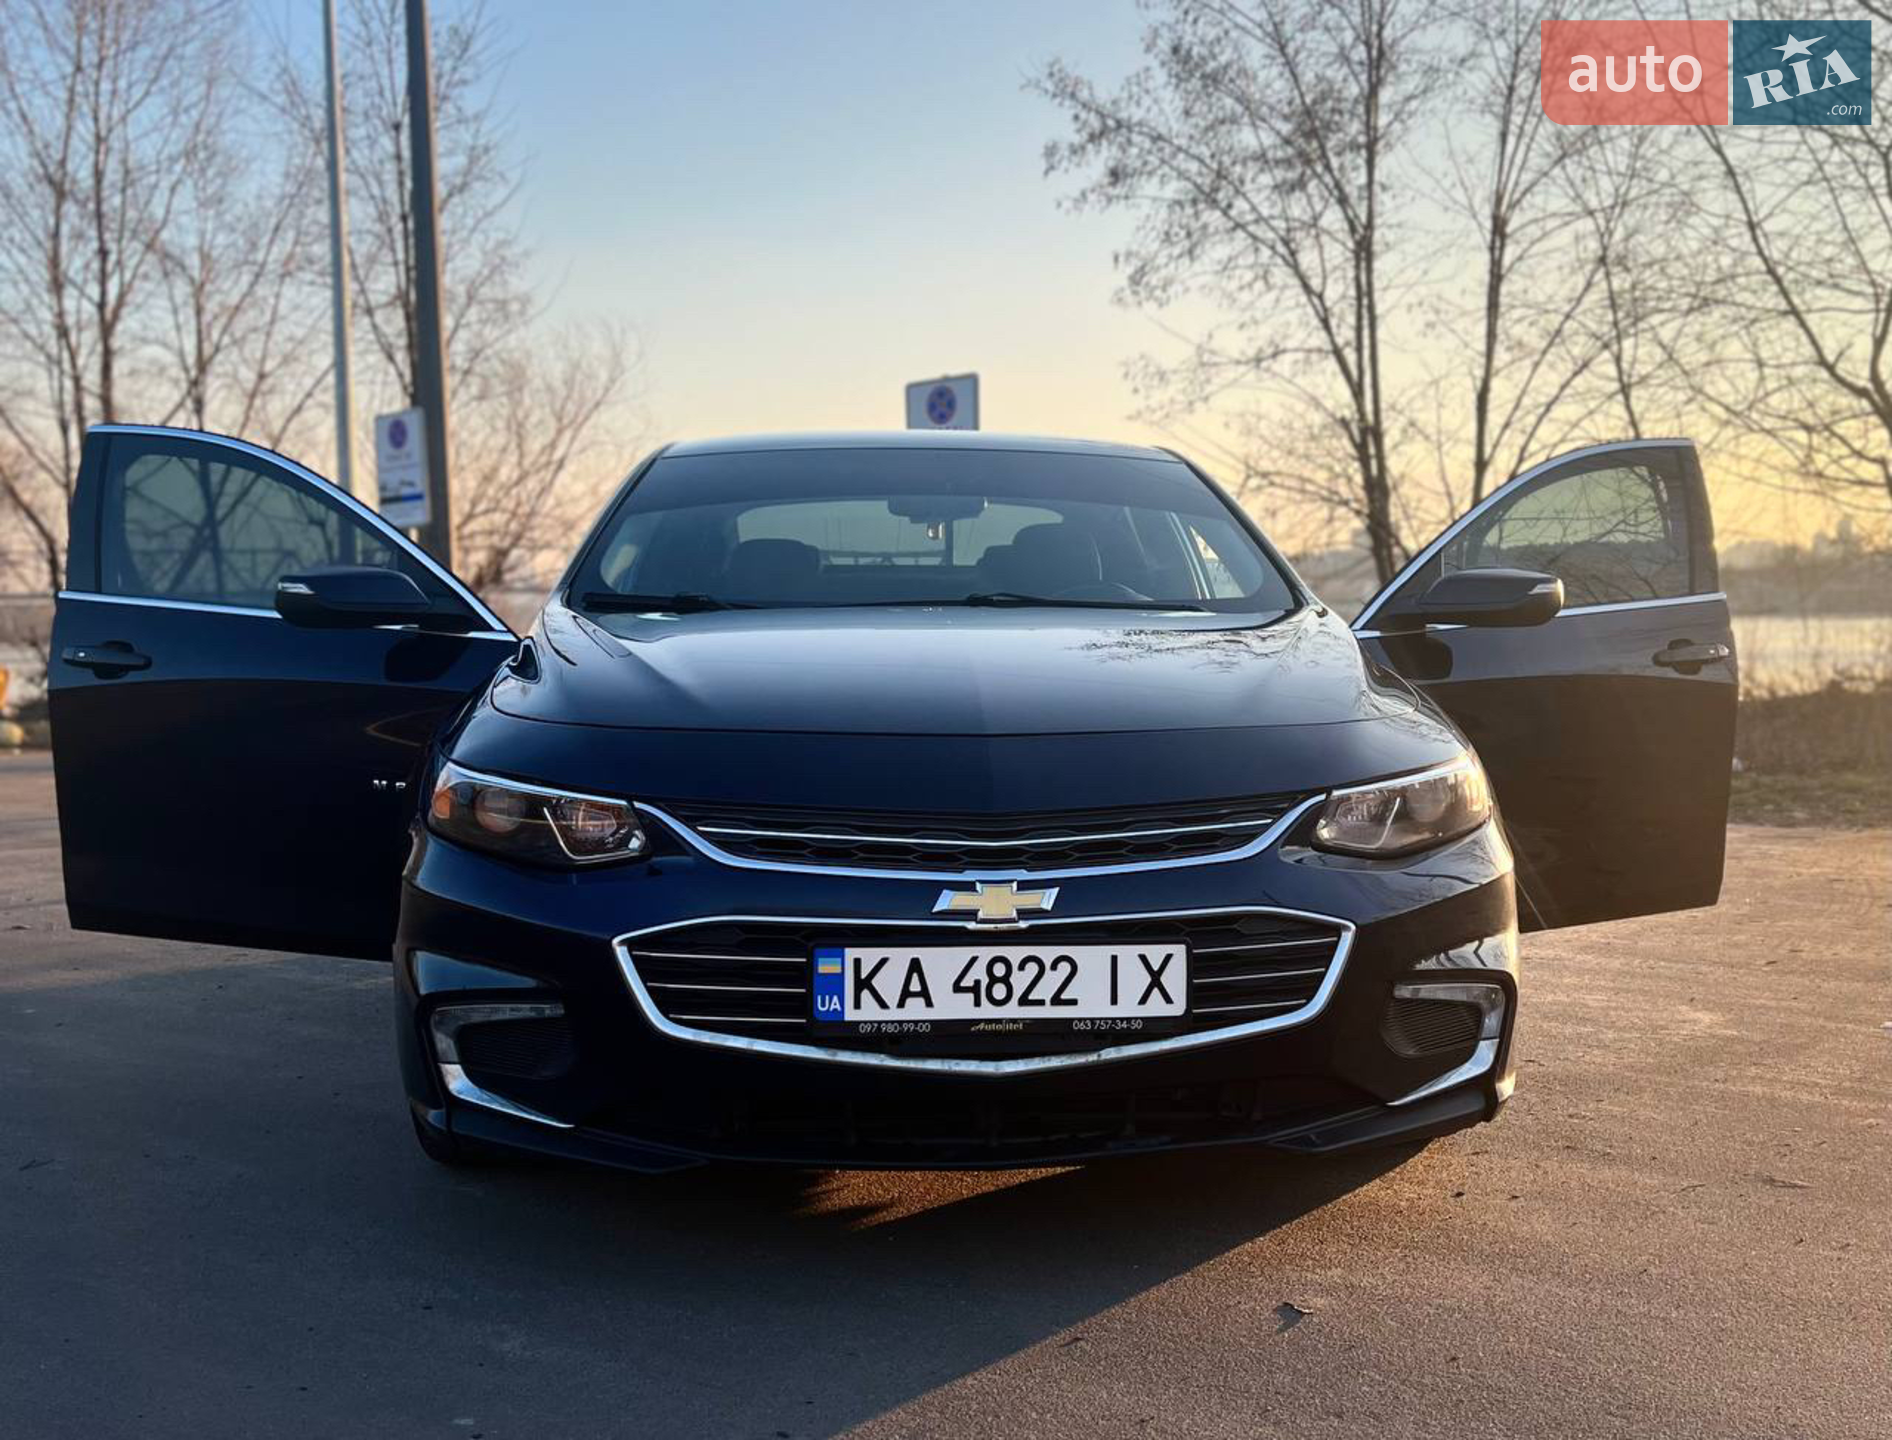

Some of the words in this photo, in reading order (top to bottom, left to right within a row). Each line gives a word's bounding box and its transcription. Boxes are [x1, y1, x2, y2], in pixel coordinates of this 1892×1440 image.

[853, 957, 934, 1010] KA
[952, 955, 1079, 1007] 4822
[1110, 953, 1175, 1006] IX
[817, 995, 842, 1011] UA
[859, 1022, 879, 1034] 097
[1072, 1019, 1092, 1030] 063
